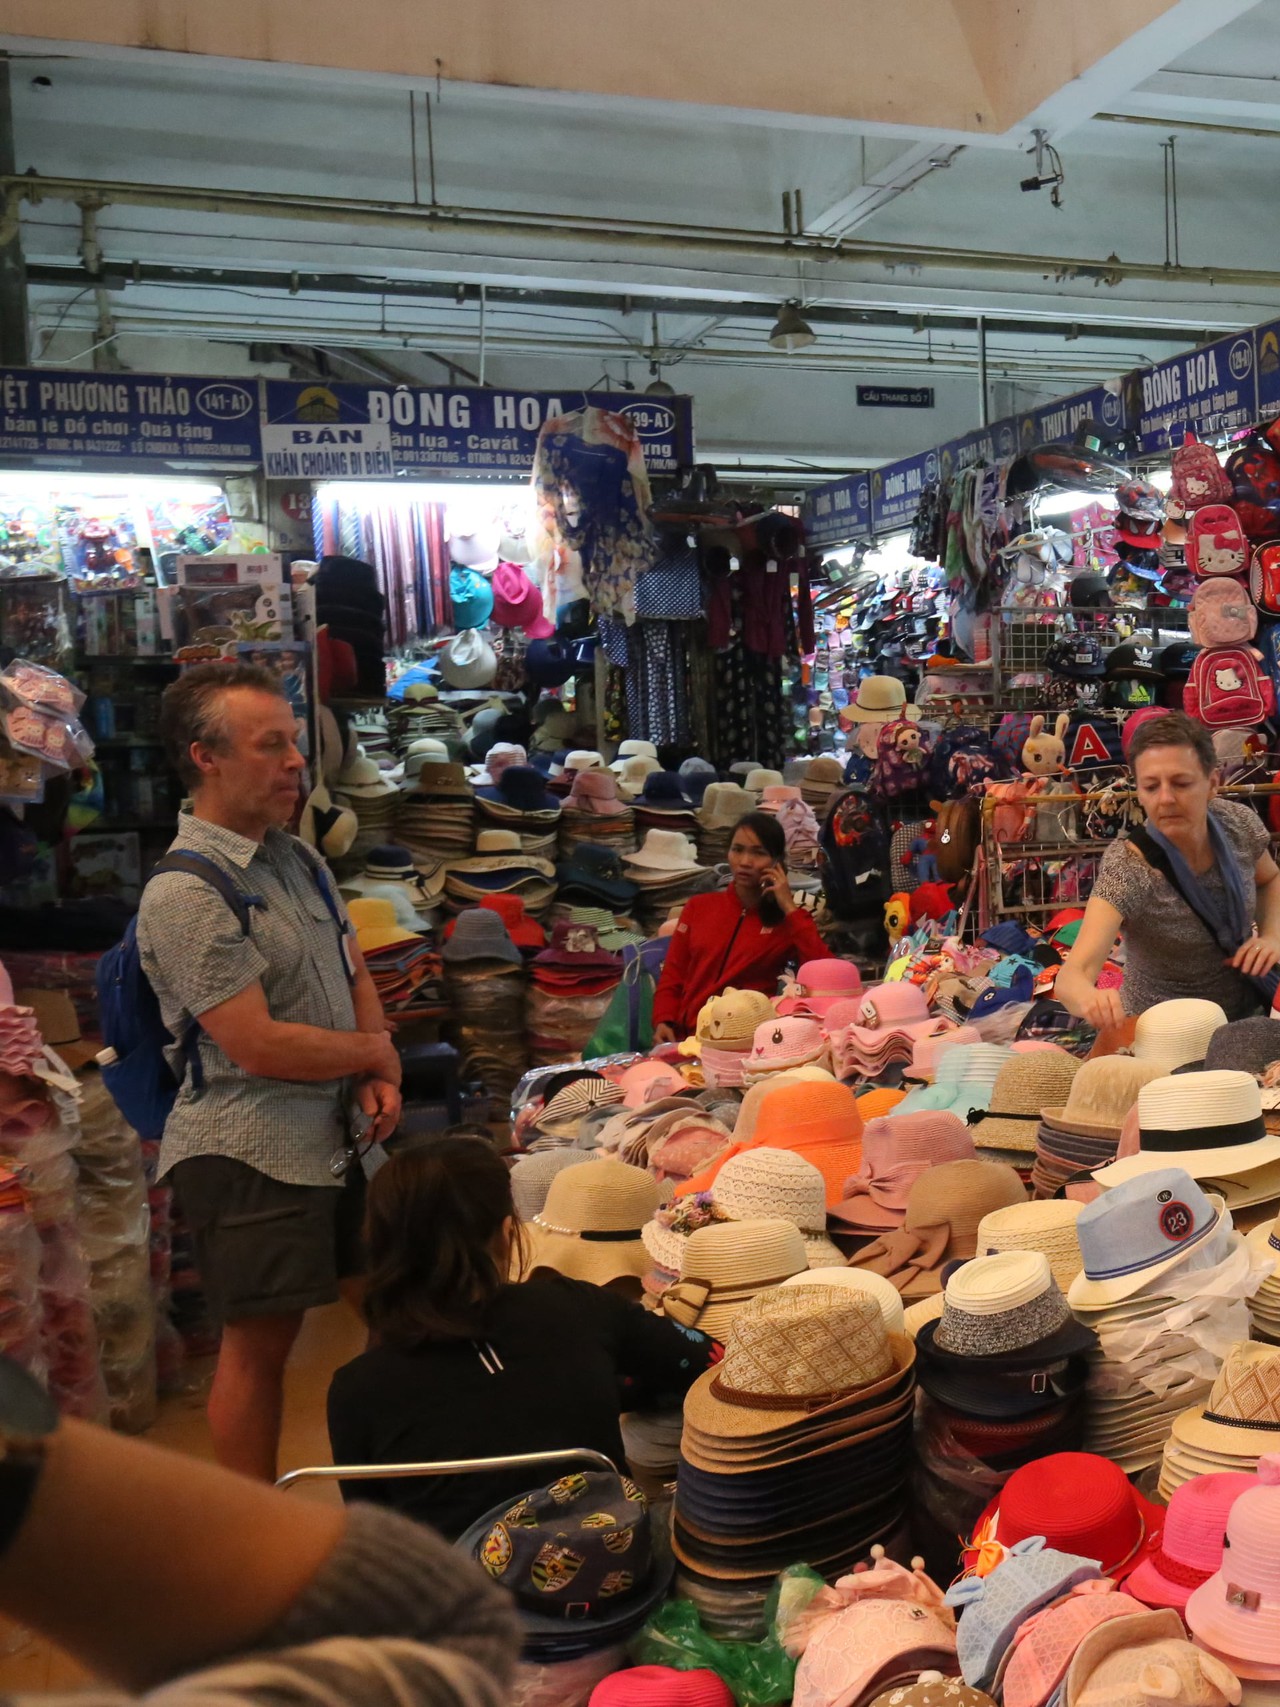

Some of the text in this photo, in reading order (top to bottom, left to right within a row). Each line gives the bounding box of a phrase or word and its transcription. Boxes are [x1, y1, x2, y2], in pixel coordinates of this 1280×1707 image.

[1142, 350, 1219, 412] ĐÔNG HOA
[39, 381, 129, 413] PHƯƠNG
[204, 393, 247, 411] 141-A1
[367, 385, 564, 431] ĐÔNG HOA
[292, 427, 362, 444] BÁN
[467, 434, 519, 451] Cavát
[643, 442, 671, 458] ưng
[302, 447, 347, 476] CHOÀNG
[1068, 724, 1112, 766] A
[1167, 1211, 1188, 1232] 23
